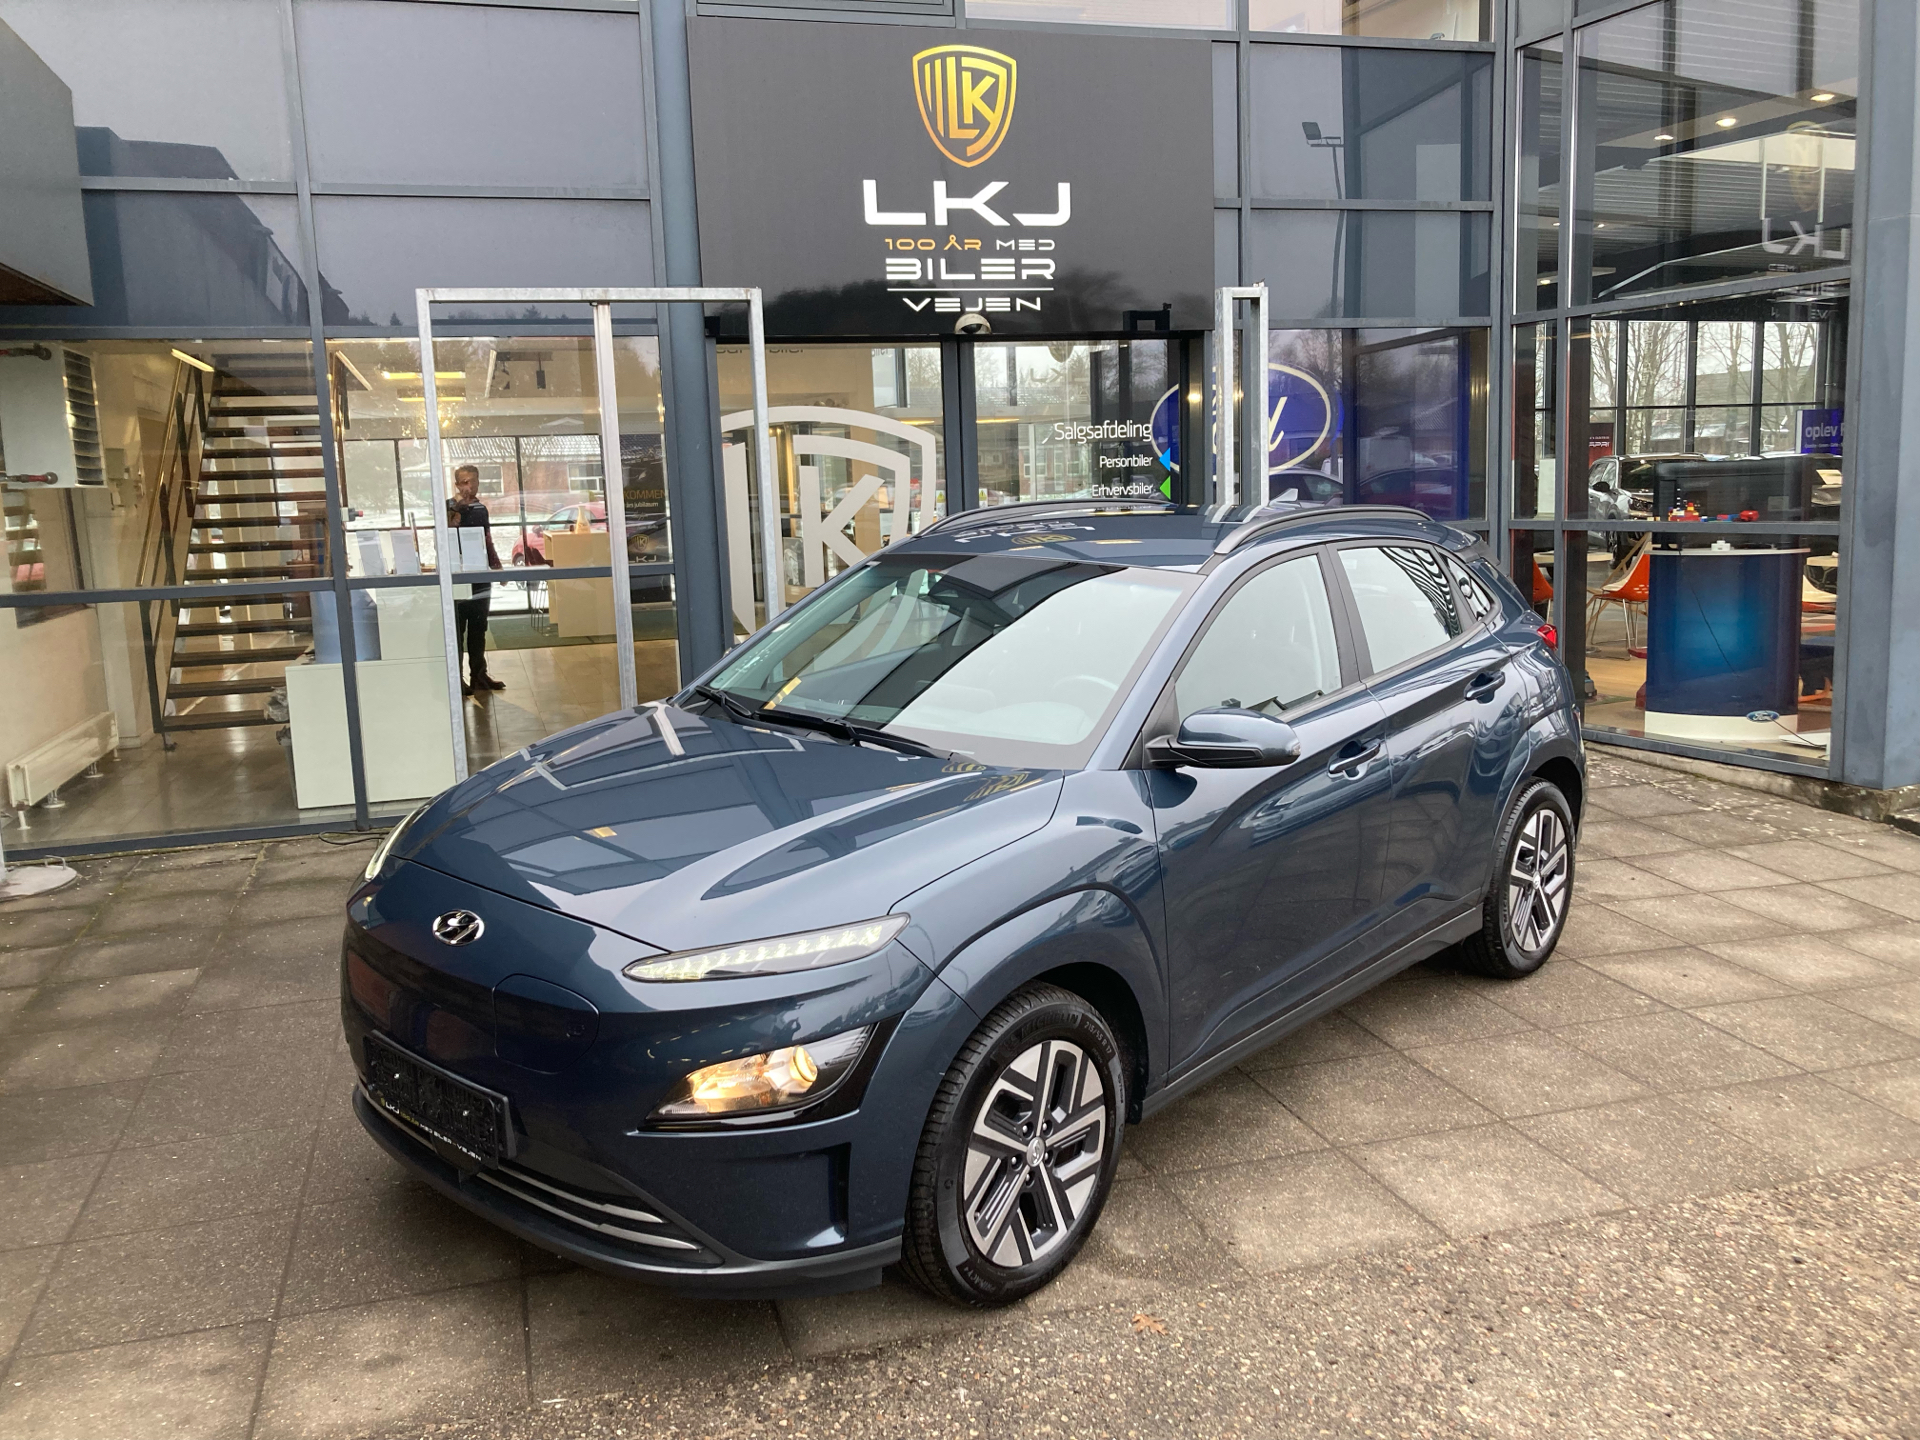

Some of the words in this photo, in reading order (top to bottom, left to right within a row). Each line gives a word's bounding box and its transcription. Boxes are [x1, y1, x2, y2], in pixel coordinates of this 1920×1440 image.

[863, 179, 1071, 226] LKJ
[884, 238, 936, 250] 100
[943, 234, 982, 250] ÅR
[996, 239, 1055, 251] MED
[885, 257, 1056, 280] BILER
[902, 297, 1041, 312] VEJEN
[1054, 420, 1152, 444] Salgsafdeling
[1805, 422, 1838, 440] oplev
[1099, 454, 1153, 468] Personbiler
[1092, 483, 1153, 497] Erhvervsbiler
